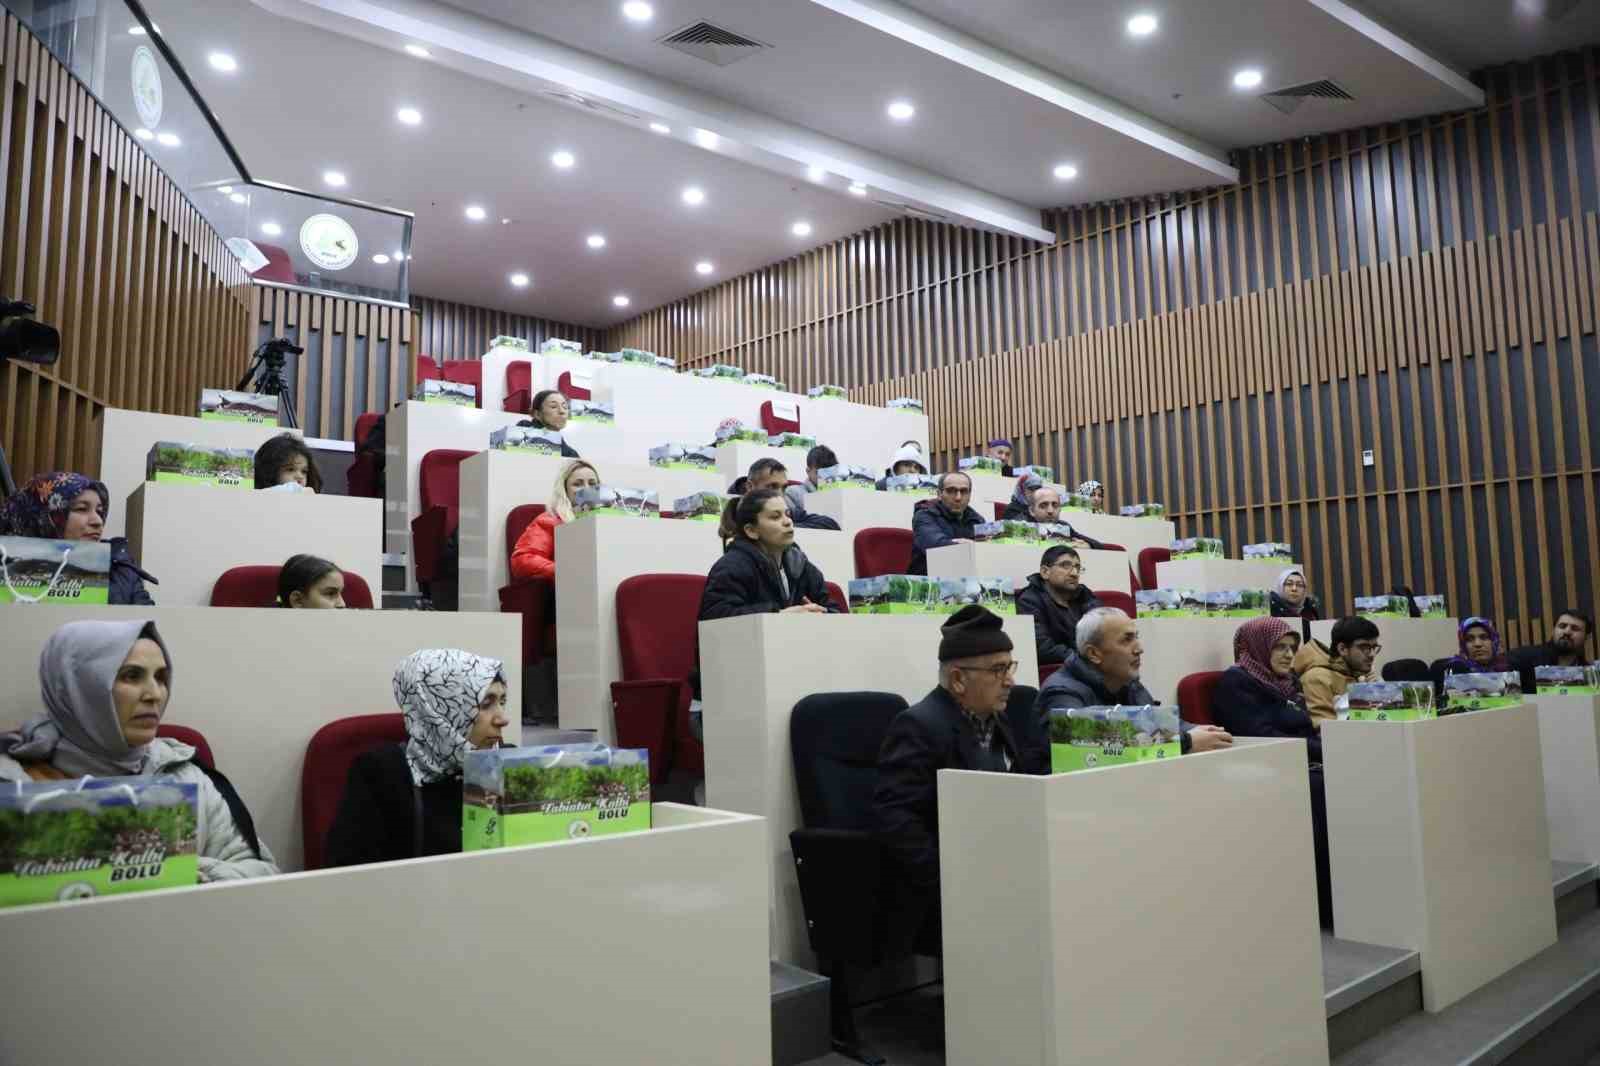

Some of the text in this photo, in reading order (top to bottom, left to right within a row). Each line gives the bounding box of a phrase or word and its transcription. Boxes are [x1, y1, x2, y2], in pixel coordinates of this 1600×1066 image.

[47, 589, 80, 598] BOLU
[598, 808, 628, 820] BOLU
[110, 846, 166, 866] Kalbi
[111, 863, 162, 881] BOLU
